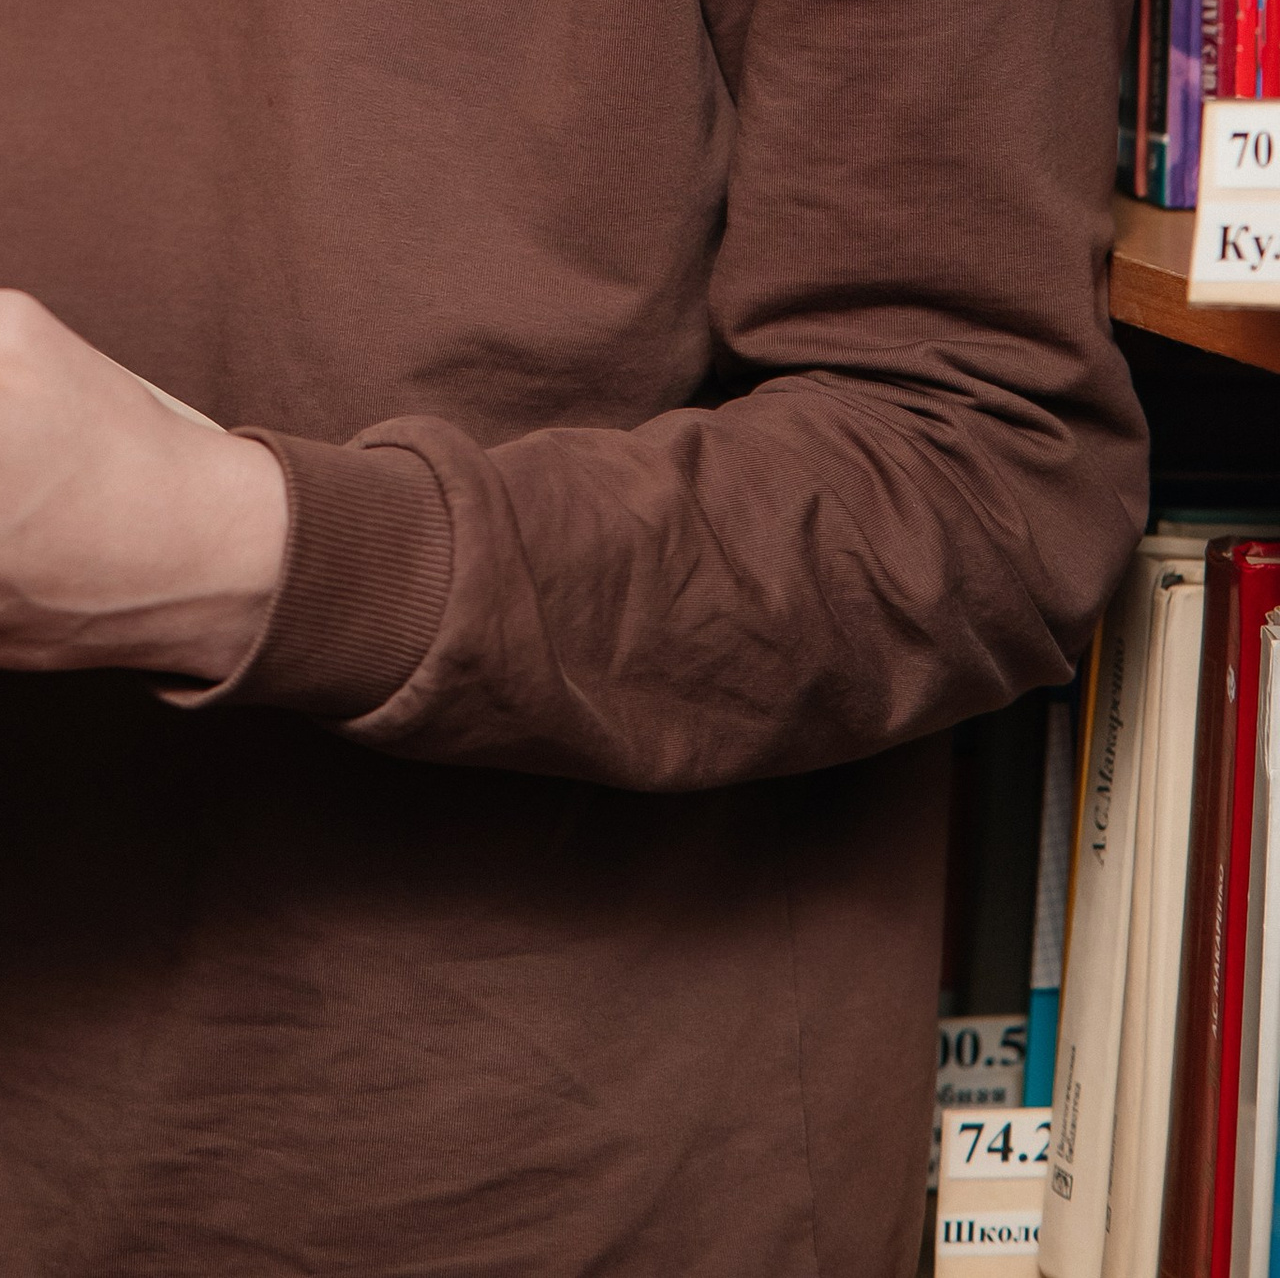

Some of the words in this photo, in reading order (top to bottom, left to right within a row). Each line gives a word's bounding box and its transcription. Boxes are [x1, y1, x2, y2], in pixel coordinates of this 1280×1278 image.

[1230, 131, 1273, 169] 70
[1218, 225, 1280, 271] Ку
[958, 1121, 1052, 1164] 74.2
